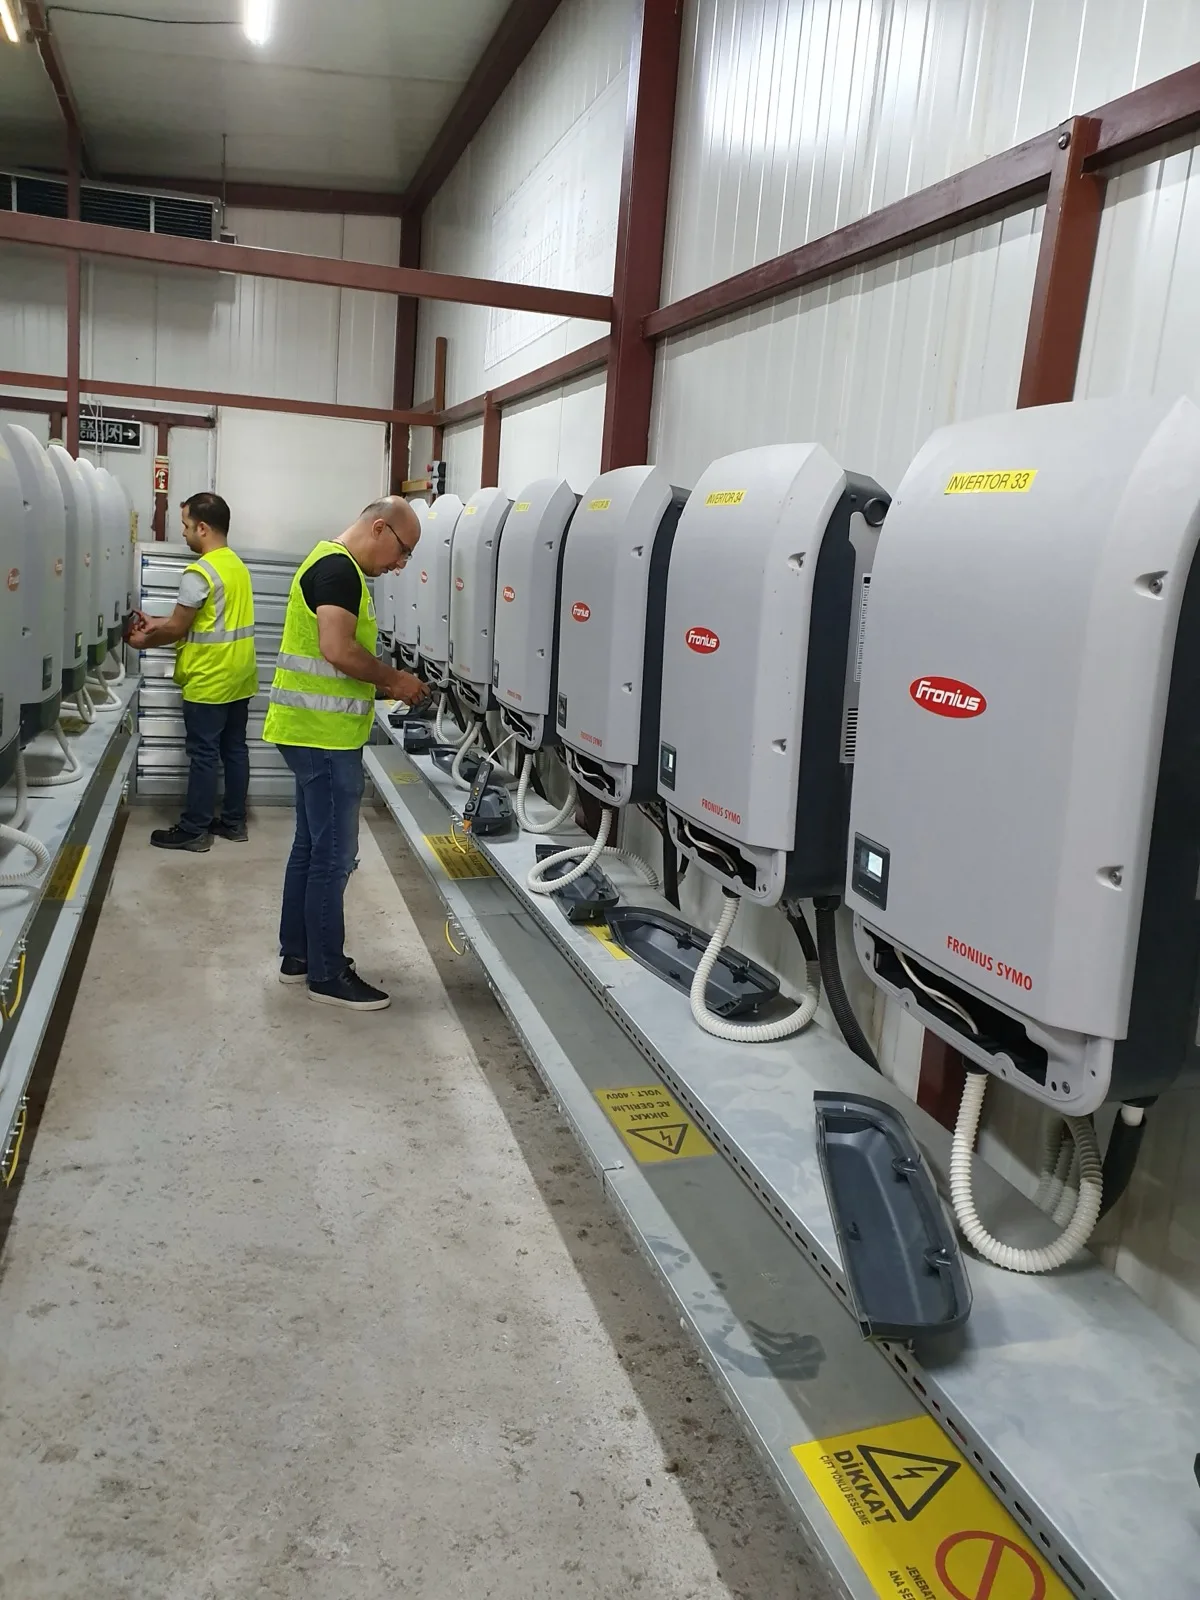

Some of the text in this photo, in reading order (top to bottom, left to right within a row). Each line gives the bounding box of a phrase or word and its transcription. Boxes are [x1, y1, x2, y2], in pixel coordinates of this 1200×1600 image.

[81, 420, 105, 430] EXT
[946, 473, 1030, 491] INVERTOR 33
[706, 492, 735, 504] INVERTOR
[687, 630, 718, 648] Fronius
[915, 680, 981, 711] Fronius
[701, 798, 741, 825] FRONIUS SYMO
[947, 935, 1033, 991] FRONIUS SYMO
[606, 1092, 629, 1100] 400V
[636, 1089, 662, 1097] VOLT
[833, 1450, 897, 1523] DİKKAT
[844, 1493, 871, 1526] BESLEME
[888, 1570, 905, 1588] ANA
